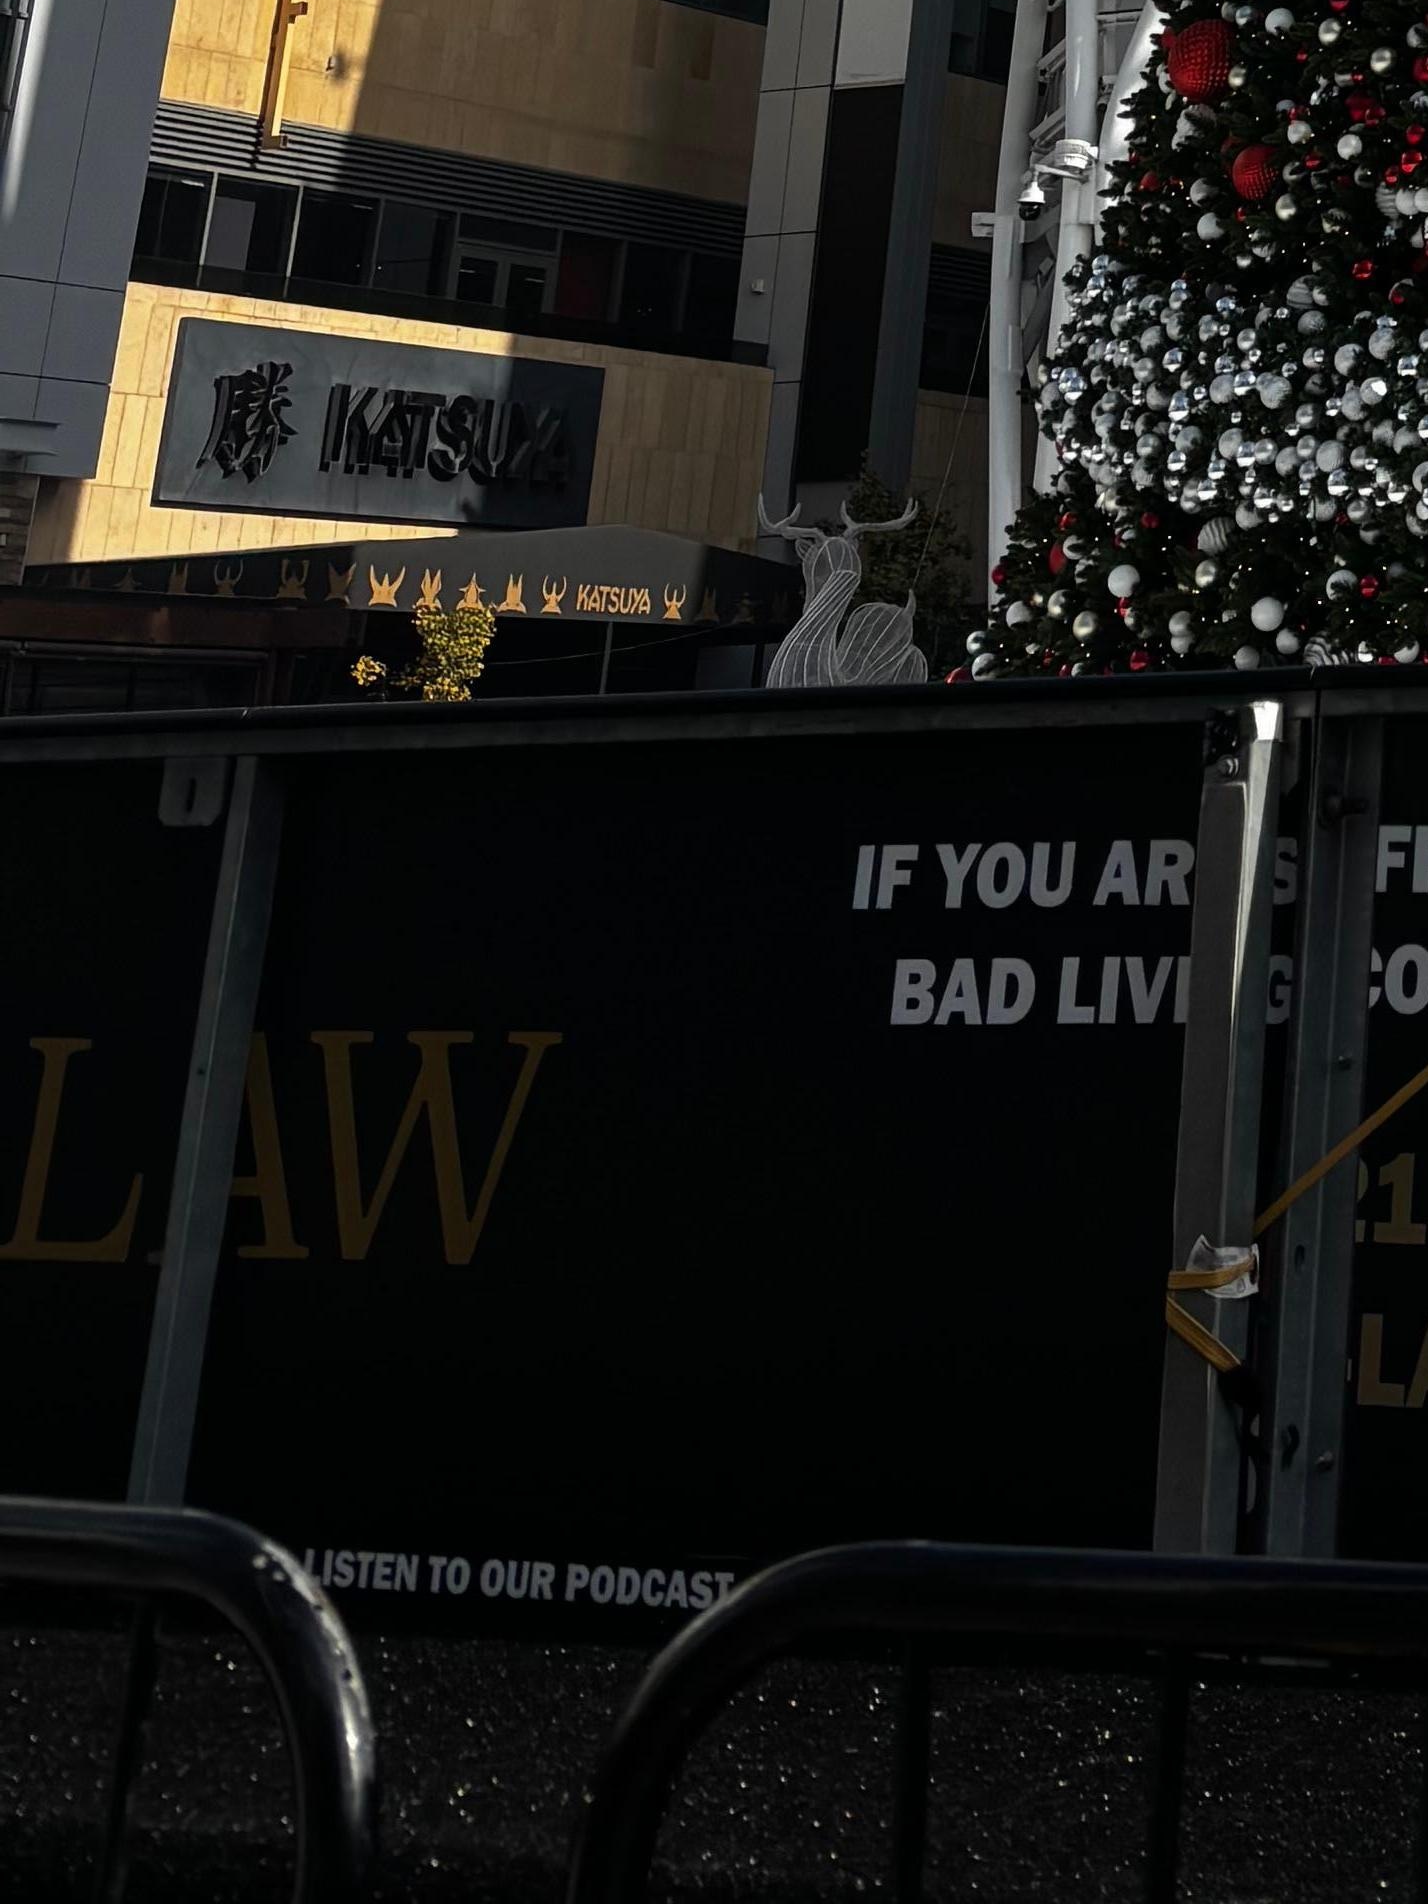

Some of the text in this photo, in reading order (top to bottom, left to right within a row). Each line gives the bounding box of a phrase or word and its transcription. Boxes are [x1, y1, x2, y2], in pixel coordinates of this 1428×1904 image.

[320, 383, 573, 490] KATSUYA
[576, 583, 651, 615] KATSUYA
[852, 843, 920, 910] IF
[936, 841, 1077, 910] YOU
[1092, 839, 1196, 907] AR
[890, 957, 1037, 1026] BAD
[0, 1030, 564, 1265] LAW
[304, 1548, 736, 1610] LISTEN TO OUR PODCAST
